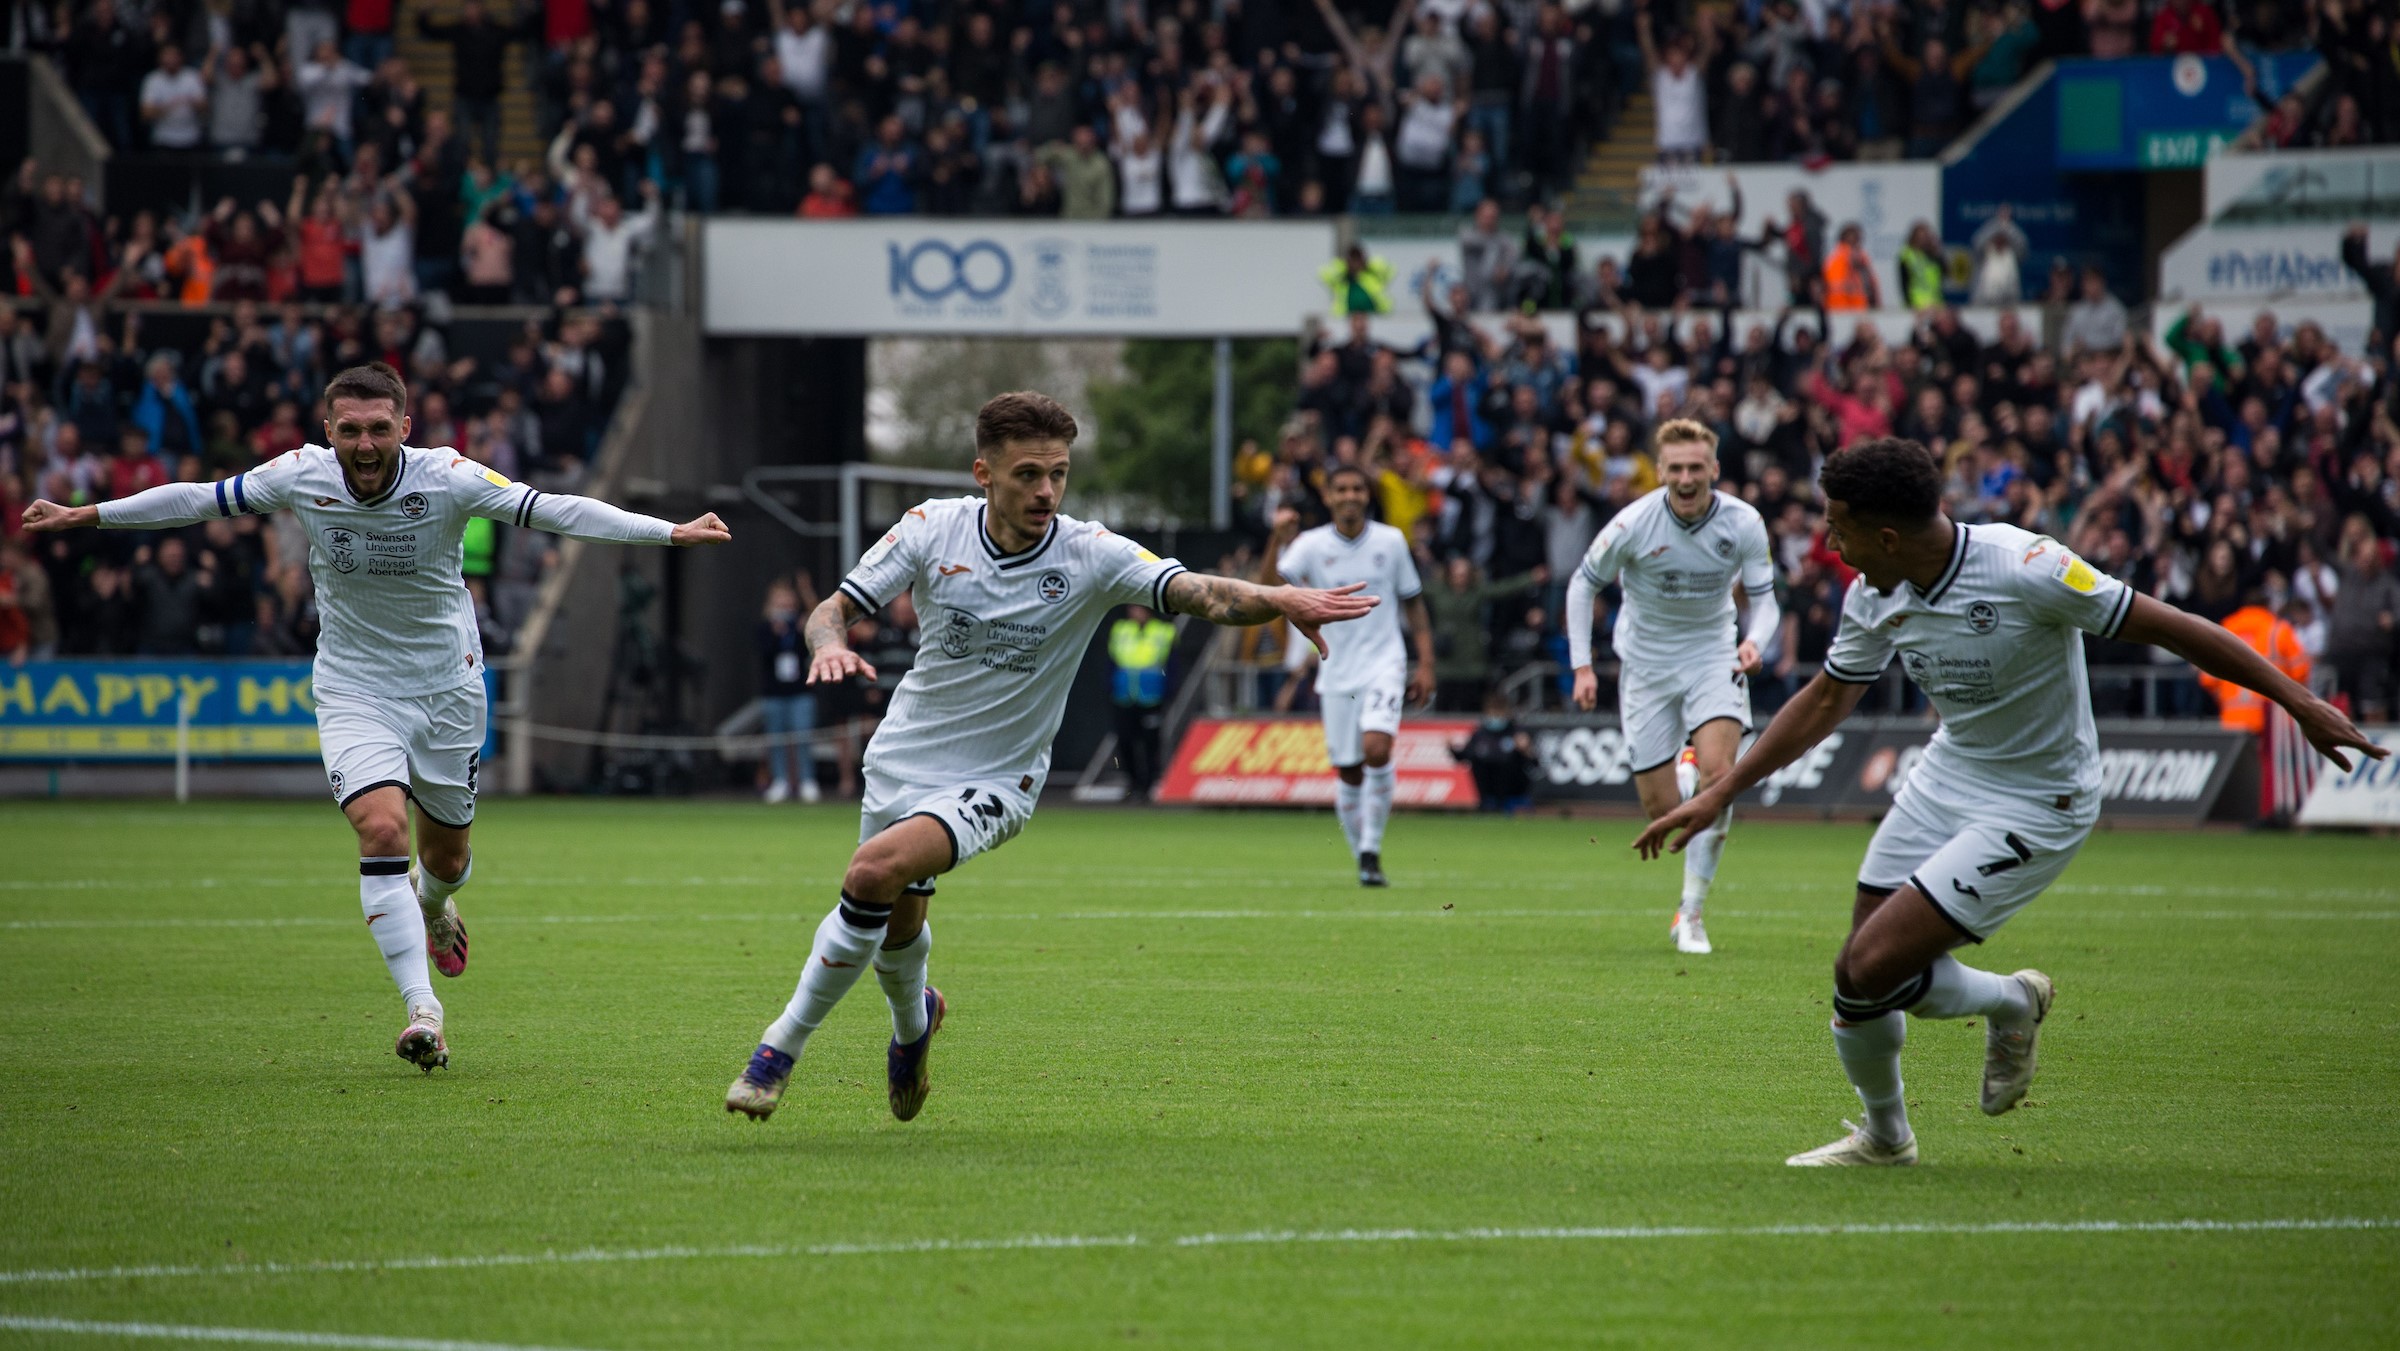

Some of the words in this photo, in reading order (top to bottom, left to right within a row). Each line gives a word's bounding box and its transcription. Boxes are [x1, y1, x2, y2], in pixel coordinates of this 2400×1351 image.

[886, 239, 1014, 302] 100
[366, 531, 417, 543] Swansea
[365, 541, 417, 554] University
[368, 558, 415, 570] Prifysgol
[367, 567, 418, 577] Abertawe
[989, 618, 1047, 635] Swansea
[986, 628, 1045, 648] University
[984, 645, 1038, 665] Prifysgol
[1938, 655, 1992, 669] Swansea
[979, 656, 1037, 675] Abertawe
[1940, 669, 1994, 682] University
[1975, 830, 2034, 879] 7
